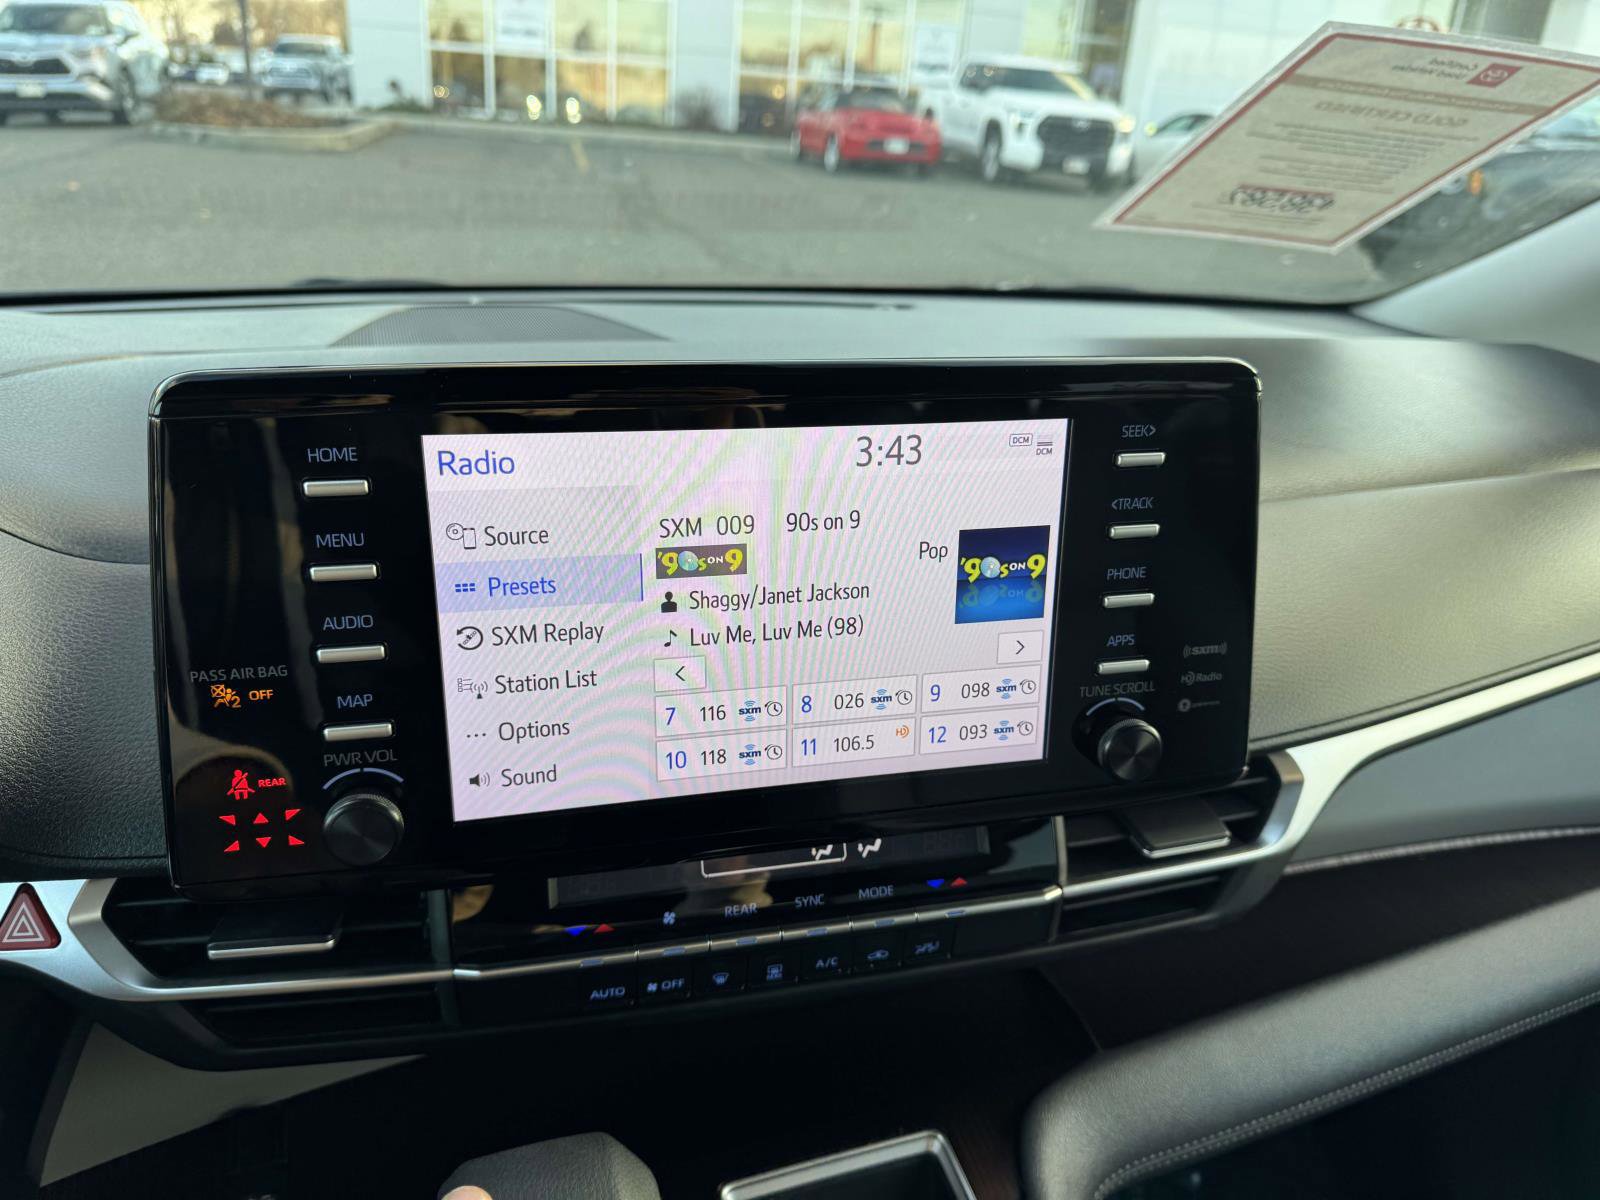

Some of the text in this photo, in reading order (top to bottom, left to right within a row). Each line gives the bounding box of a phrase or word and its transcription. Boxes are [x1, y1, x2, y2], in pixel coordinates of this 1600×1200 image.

[1121, 424, 1149, 437] SEEK
[1012, 436, 1030, 445] DCM
[307, 447, 358, 463] HOME
[856, 434, 922, 467] 3:43
[1036, 448, 1053, 456] DCM
[437, 449, 515, 476] Radio
[1118, 497, 1154, 510] TRACK
[659, 509, 861, 539] SXM 009 90s on 9
[316, 532, 365, 548] MENU
[484, 526, 549, 546] Source
[707, 555, 724, 565] ON
[724, 548, 744, 573] 9
[919, 540, 948, 563] Pop
[1009, 561, 1026, 571] ON
[1026, 553, 1046, 579] 9
[1106, 566, 1147, 580] PHONE
[488, 577, 556, 597] Presets
[689, 582, 869, 611] Shaggy/Janet Jackson
[323, 614, 374, 631] AUDIO
[690, 614, 865, 647] Luv Me, Luv Me (98)
[491, 621, 604, 646] SXM Replay
[1107, 634, 1136, 647] APPS
[190, 664, 288, 682] PASS AIR BAG
[495, 670, 597, 694] Station List
[1196, 672, 1222, 682] Radio
[249, 689, 274, 700] OFF
[930, 682, 1017, 702] 9 098 sxm
[1080, 681, 1155, 698] TUNE SCROLL
[337, 694, 373, 709] MAP
[801, 692, 893, 714] 8 026 sxm
[665, 704, 762, 726] 7 116 sxm
[498, 721, 570, 744] Options
[928, 724, 1014, 744] 12 093 sxm
[801, 738, 817, 756] 11
[833, 734, 875, 754] 106.5
[323, 749, 397, 767] PWR VOL
[666, 748, 762, 770] 10 118 sxm
[258, 777, 286, 788] REAR
[501, 764, 557, 787] Sound
[795, 893, 825, 908] SYNC
[858, 885, 894, 899] MODE
[725, 903, 758, 917] REAR
[815, 957, 839, 969] A/C
[590, 986, 625, 999] AUTO
[661, 979, 685, 990] OFF
